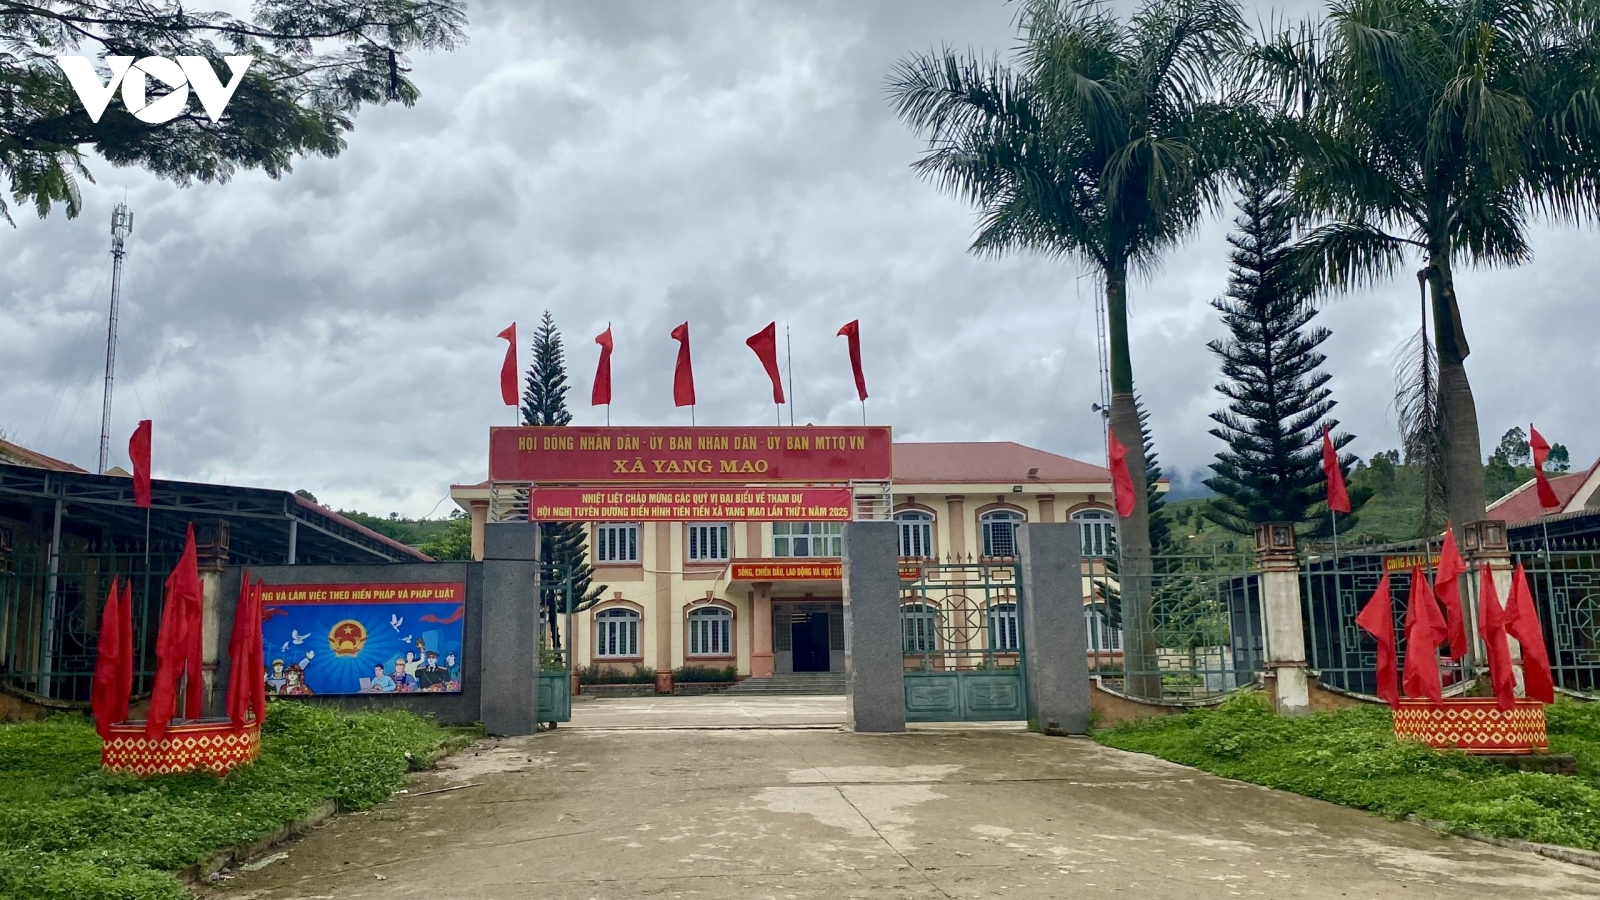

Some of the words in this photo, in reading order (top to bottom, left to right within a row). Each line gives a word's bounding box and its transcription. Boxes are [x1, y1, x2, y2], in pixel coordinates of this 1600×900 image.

[518, 433, 537, 453] HỘI
[543, 432, 574, 450] ĐỒNG
[580, 433, 611, 450] NHÂN
[617, 433, 640, 450] DÂN
[649, 432, 663, 450] ỦY
[669, 436, 692, 450] BAN
[698, 433, 729, 450] NHÂN
[734, 433, 757, 450] DÂN
[767, 432, 780, 450] ỦY
[786, 436, 810, 450] BAN
[815, 436, 846, 451] MTTQ
[849, 436, 865, 450] VN
[613, 456, 647, 473] XÃ
[651, 459, 714, 473] YANG
[719, 459, 769, 473] MAO
[582, 491, 606, 505] NHIỆT
[607, 491, 624, 505] LIỆT
[625, 491, 647, 504] CHÀO
[648, 491, 673, 504] MỪNG
[674, 491, 691, 504] CÁC
[692, 491, 708, 504] QUÝ
[710, 493, 718, 505] VỊ
[720, 493, 734, 505] ĐẠI
[767, 493, 790, 504] THAM
[791, 493, 804, 506] DỰ
[537, 505, 551, 518] HỘI
[552, 506, 572, 518] NGHỊ
[574, 505, 599, 517] TUYÊN
[601, 506, 629, 517] DƯƠNG
[651, 504, 671, 517] HÌNH
[672, 505, 691, 517] TIÊN
[692, 504, 710, 517] TIẾN
[712, 505, 723, 517] XÃ
[725, 506, 745, 517] YANG
[747, 506, 766, 517] MAO
[785, 504, 801, 517] THỨ
[801, 506, 807, 517] I
[808, 505, 827, 517] NĂM
[828, 507, 848, 517] 2025
[276, 589, 287, 601] VÀ
[288, 589, 306, 601] LÀM
[308, 589, 327, 602] VIỆC
[329, 590, 350, 600] THEO
[351, 587, 372, 600] HIẾN
[373, 588, 396, 600] PHÁP
[397, 588, 408, 599] VÀ
[410, 587, 433, 599] PHÁP
[434, 587, 455, 600] LUẬT
